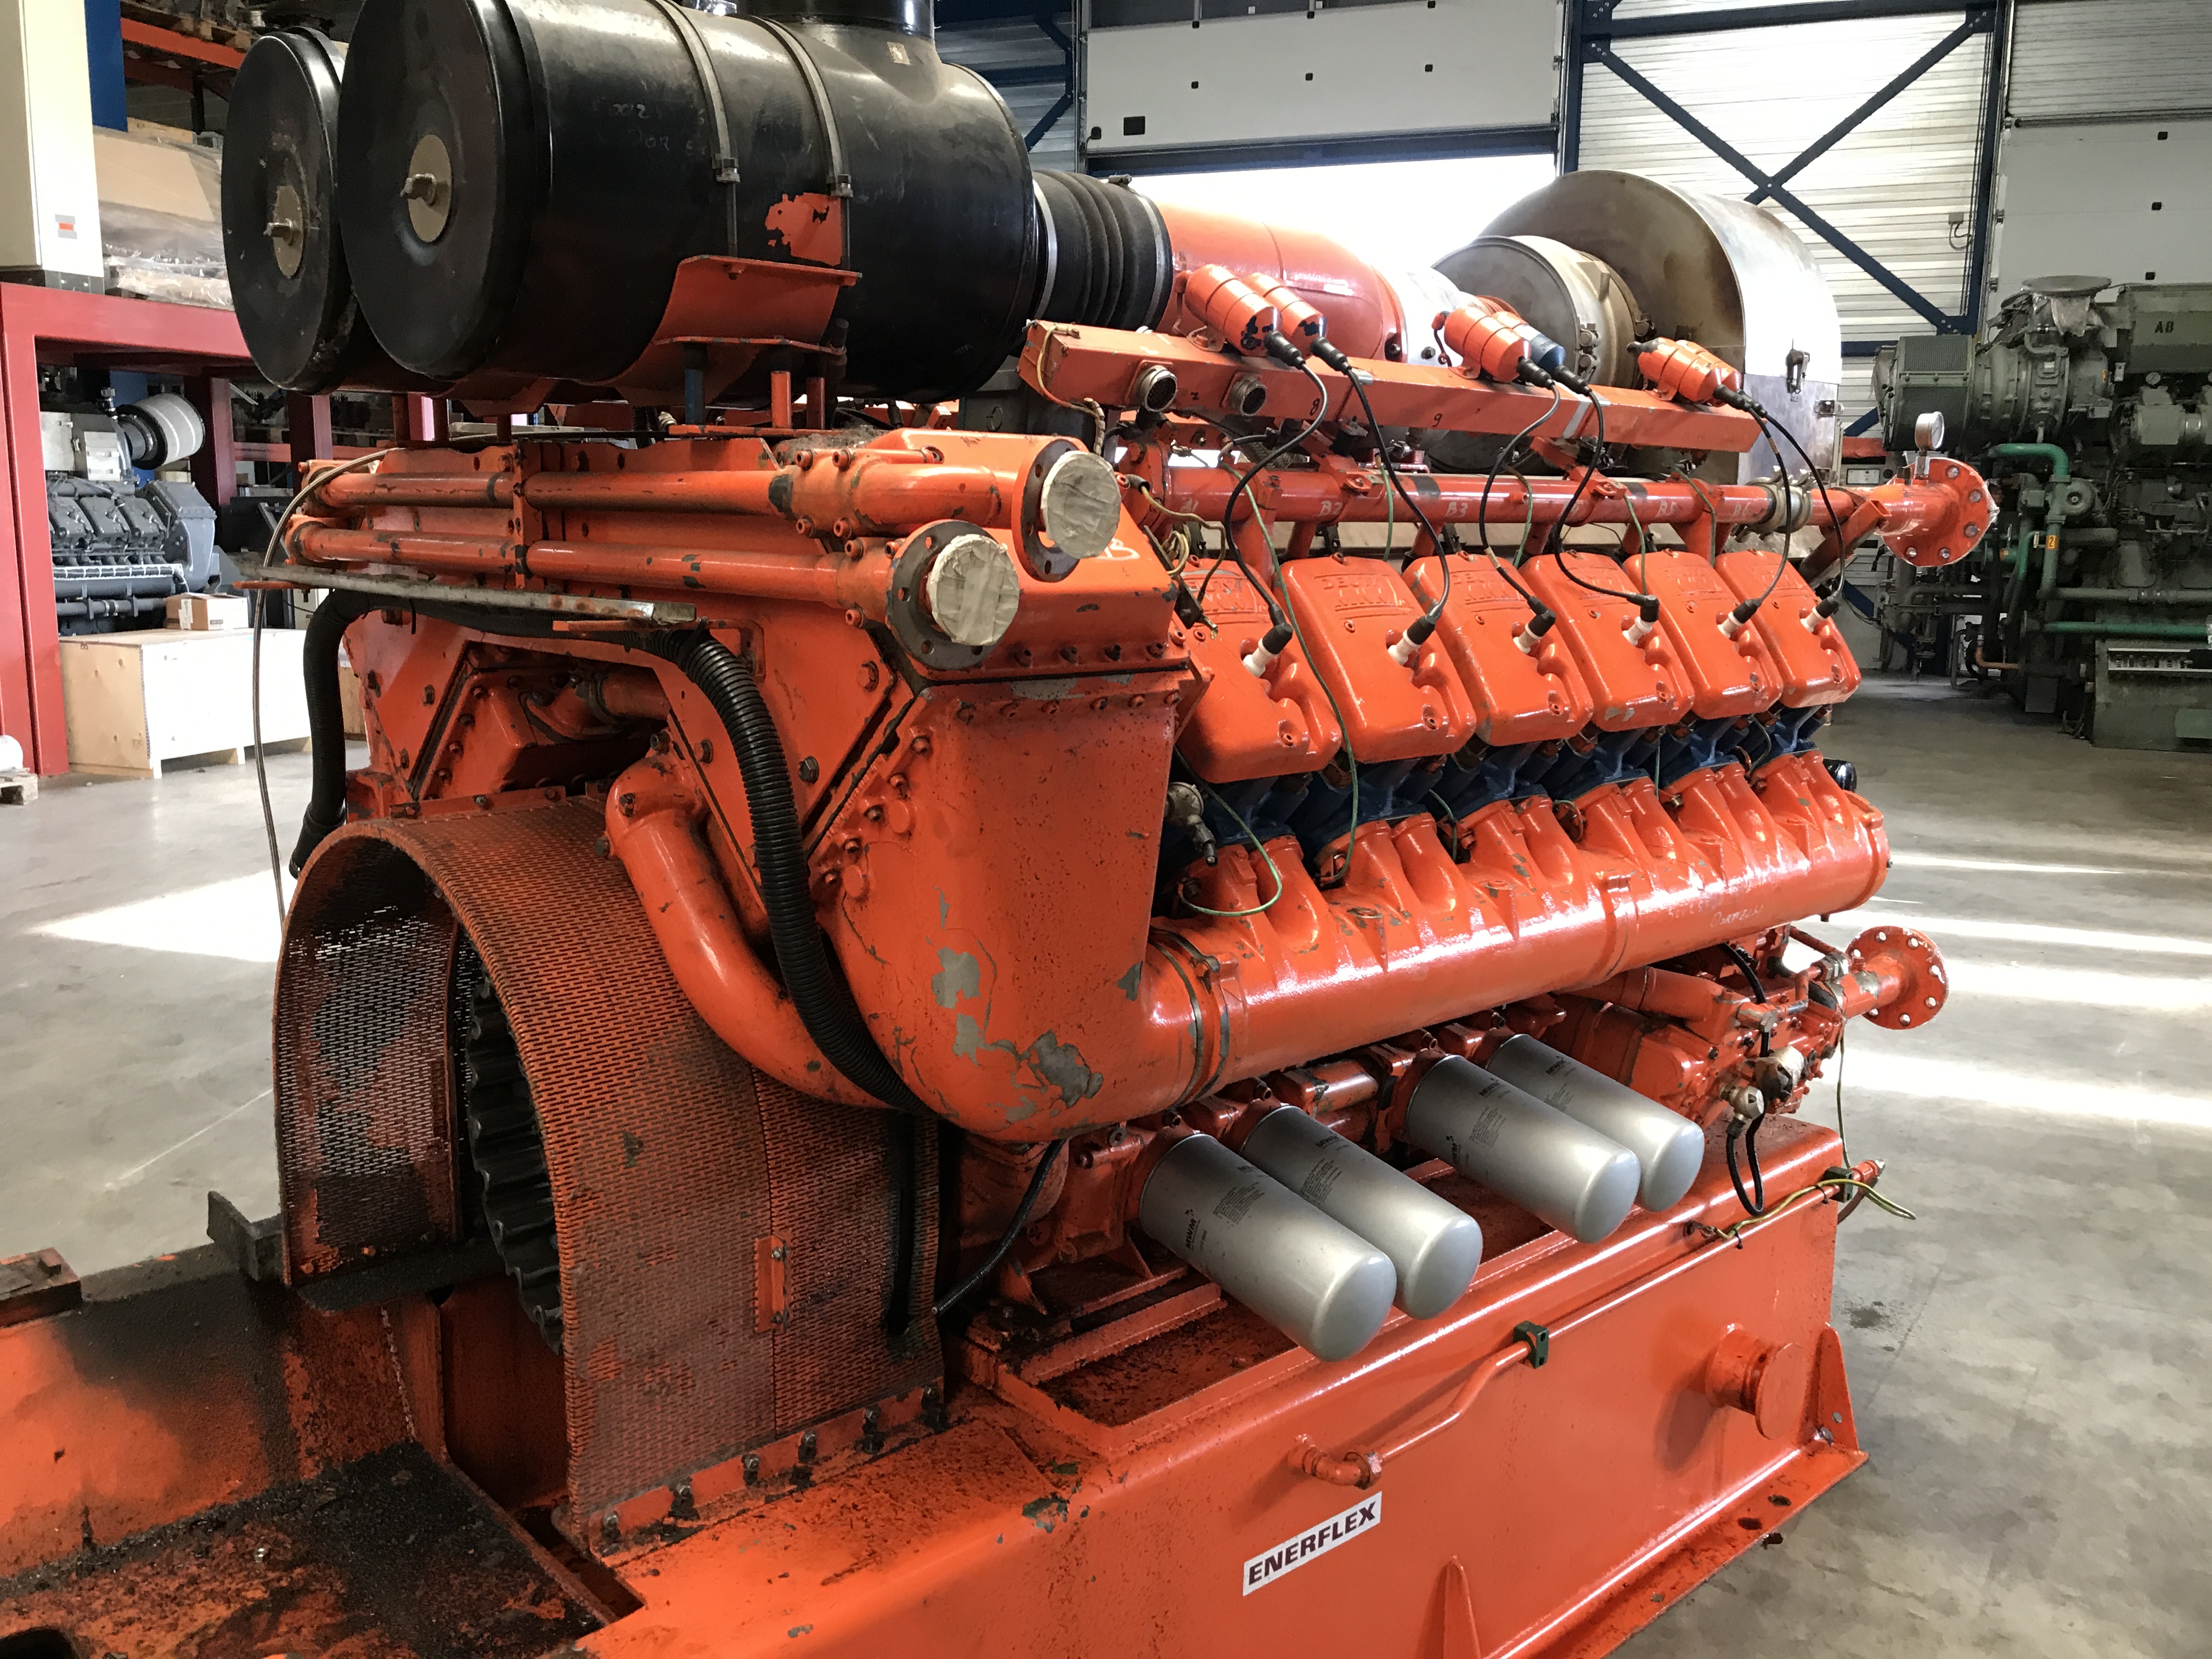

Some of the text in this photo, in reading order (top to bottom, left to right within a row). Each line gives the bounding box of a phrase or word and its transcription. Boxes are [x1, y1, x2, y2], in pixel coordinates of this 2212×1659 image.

[1310, 398, 1321, 416] 8
[1432, 413, 1443, 427] 9
[2049, 536, 2055, 548] 2
[1185, 1218, 1197, 1250] MWM
[1248, 1501, 1376, 1585] ENERFLEX
